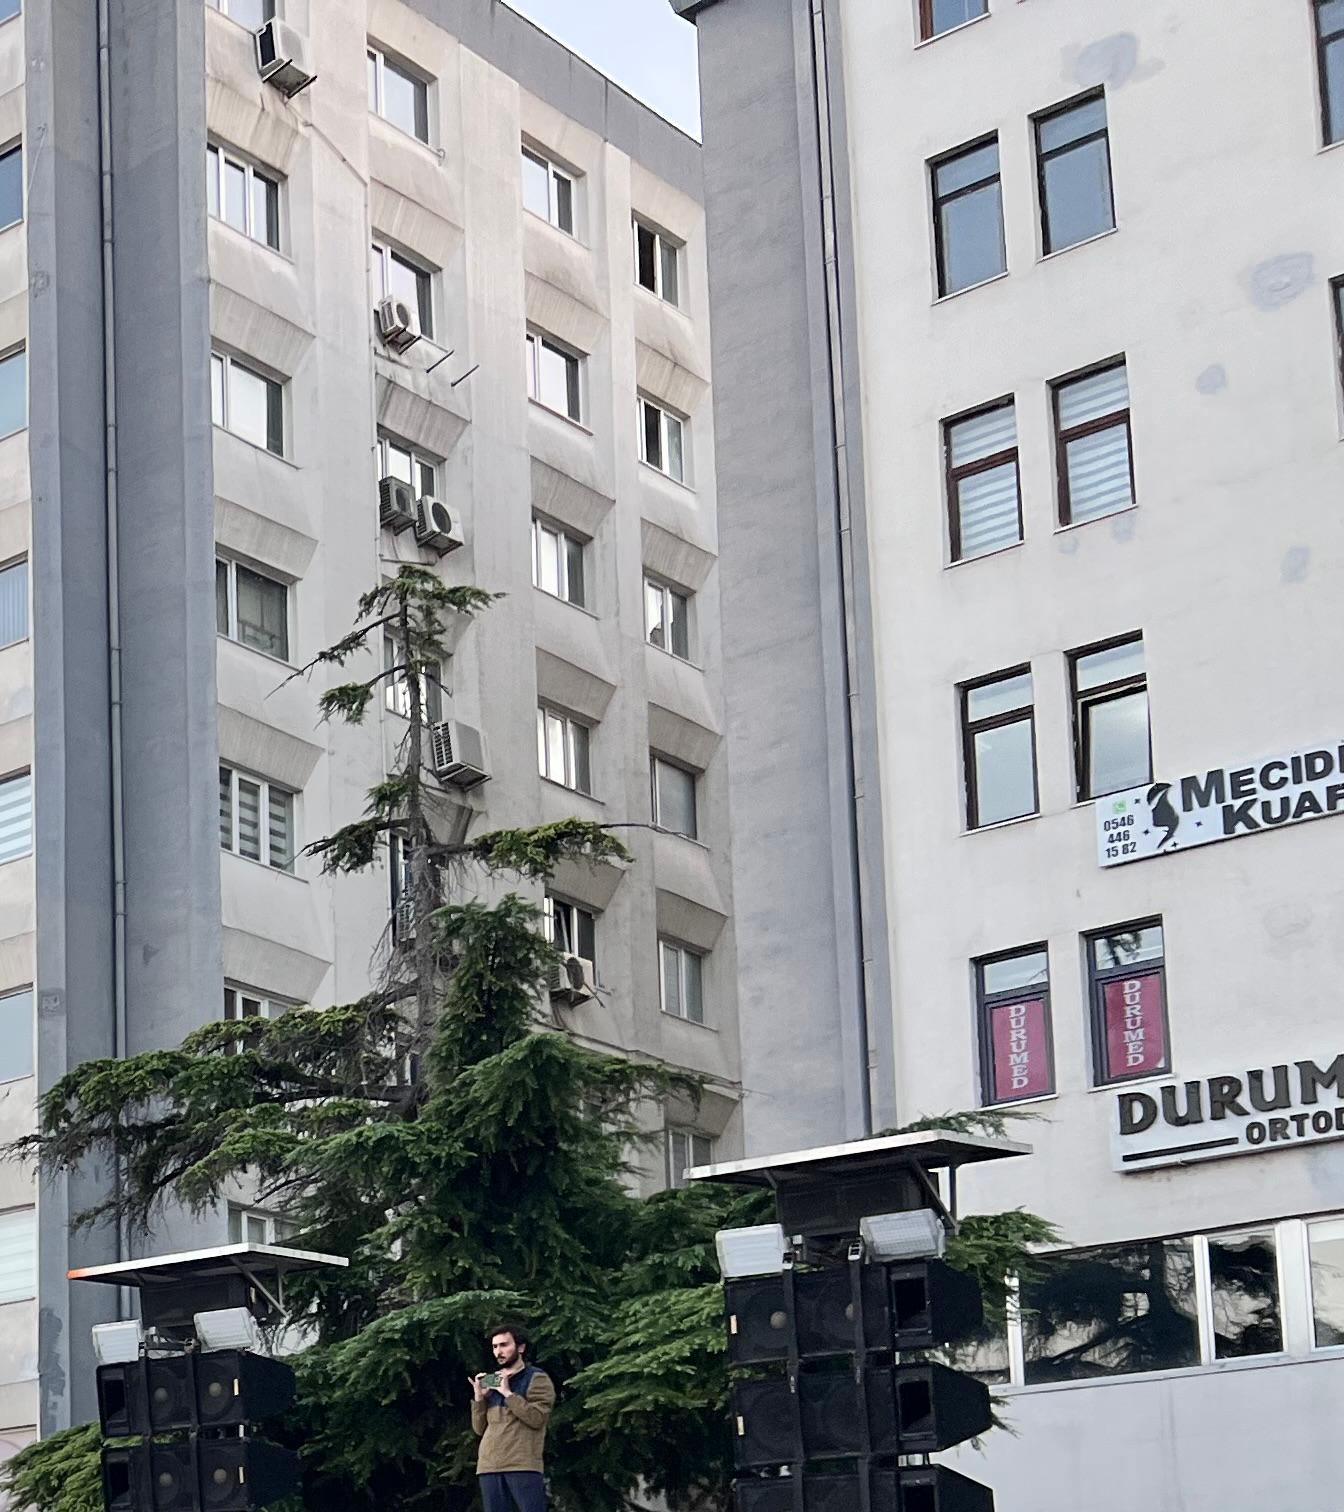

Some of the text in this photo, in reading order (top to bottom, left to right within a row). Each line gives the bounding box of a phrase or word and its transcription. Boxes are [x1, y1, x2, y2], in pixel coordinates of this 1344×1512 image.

[1103, 814, 1134, 832] 0546
[1108, 829, 1130, 844] 446
[1105, 845, 1119, 858] 15
[1009, 1004, 1029, 1089] DURUMED
[1123, 979, 1144, 1067] DURUMED
[1117, 1053, 1344, 1135] DURUM
